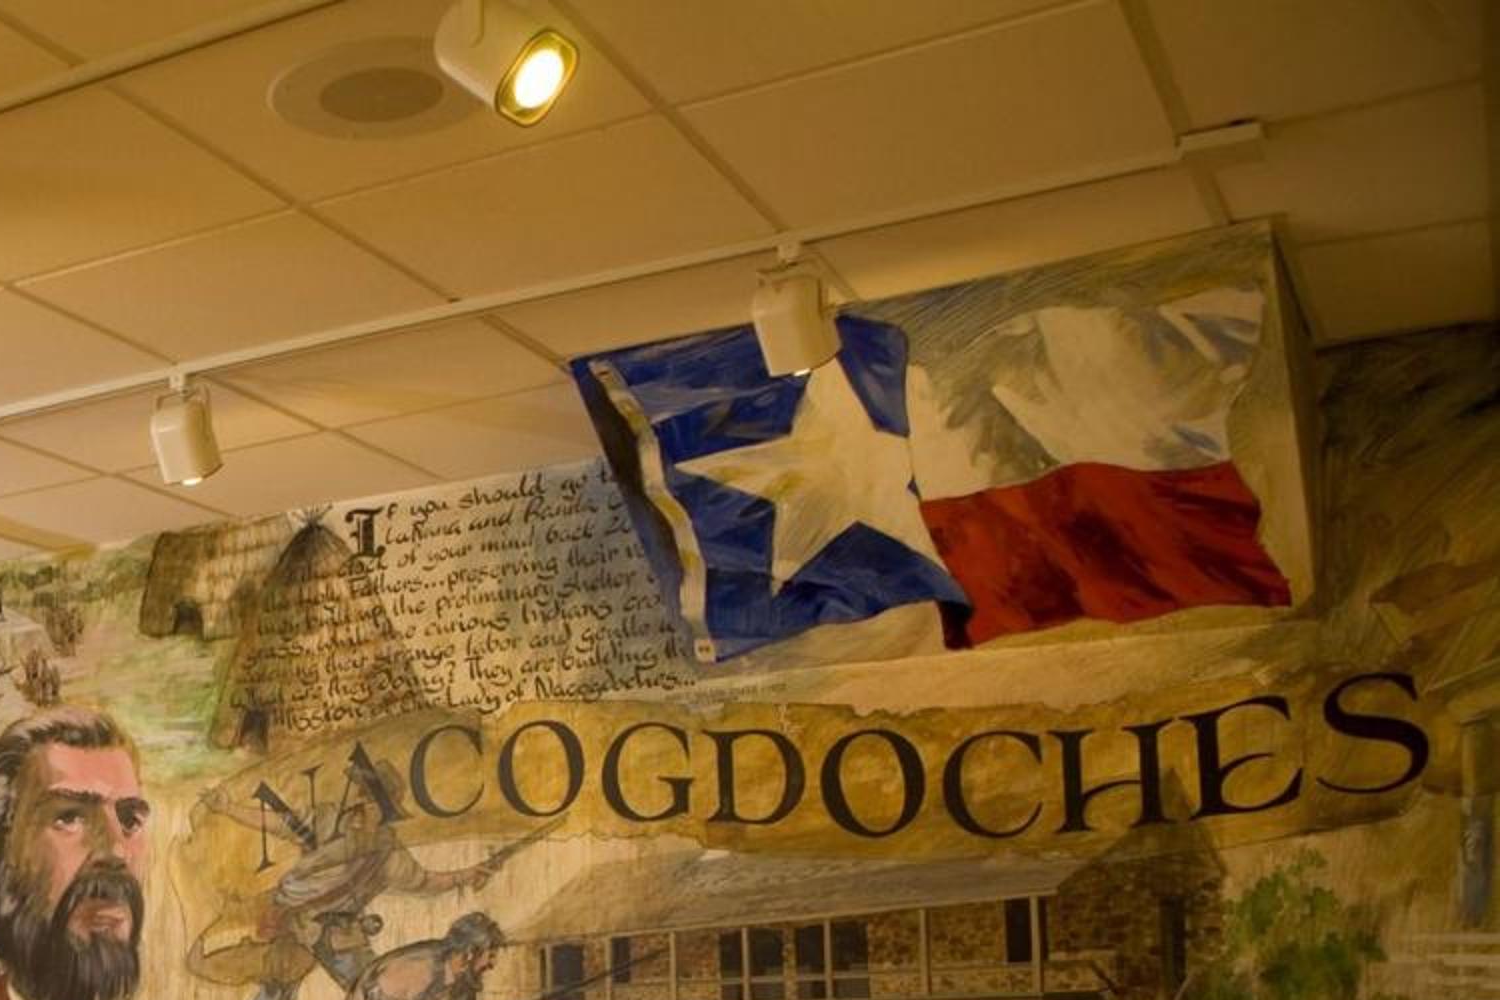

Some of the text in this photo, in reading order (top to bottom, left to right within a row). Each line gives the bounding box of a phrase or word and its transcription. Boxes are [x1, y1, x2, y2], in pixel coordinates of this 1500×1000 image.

[409, 500, 449, 526] you
[457, 471, 548, 510] should
[560, 474, 588, 501] go
[468, 503, 516, 532] and
[396, 546, 417, 570] of
[422, 544, 474, 572] your
[480, 524, 535, 554] mind
[568, 543, 619, 568] their
[392, 593, 427, 616] the
[435, 582, 554, 620] preliminary
[423, 609, 512, 638] curious
[521, 599, 615, 625] Indians
[465, 631, 522, 658] labor
[528, 619, 572, 649] and
[463, 655, 514, 687] They
[519, 656, 555, 675] are
[560, 638, 658, 672] building
[445, 681, 502, 716] Lady
[505, 675, 530, 704] of
[254, 671, 1432, 873] NACOGDOCHES
